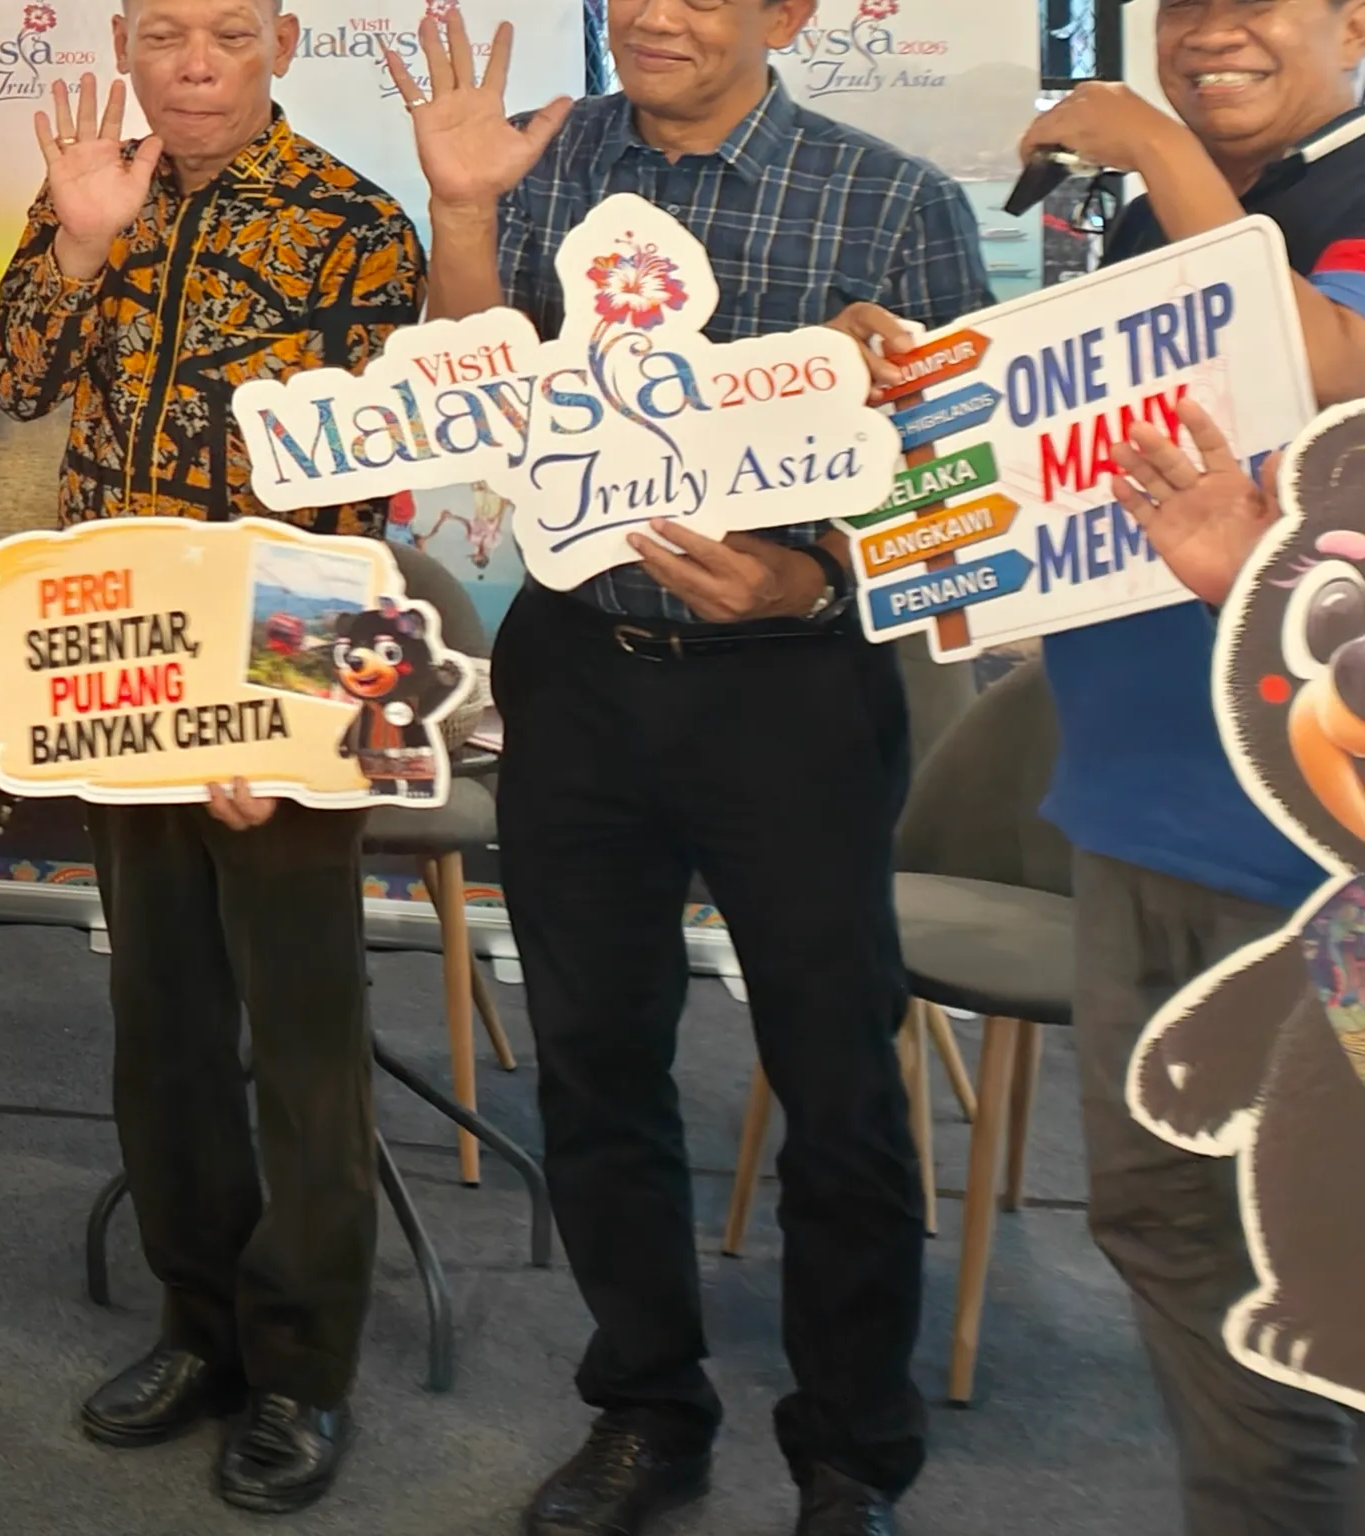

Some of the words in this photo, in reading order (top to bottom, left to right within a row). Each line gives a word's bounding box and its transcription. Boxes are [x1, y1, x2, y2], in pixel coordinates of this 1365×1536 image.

[55, 51, 95, 64] 2026
[890, 69, 946, 87] Asia
[413, 340, 519, 389] Visit
[1006, 326, 1108, 428] ONE
[1116, 282, 1234, 387] TRIP
[256, 328, 712, 485] Malaysia
[711, 356, 837, 409] 2026
[530, 450, 708, 554] Truly
[725, 435, 862, 496] Asia
[869, 507, 994, 565] LANGKAWI
[39, 569, 132, 619] PERGI
[889, 566, 998, 616] PENANG
[26, 611, 201, 672] SEBENTAR,
[50, 662, 184, 716] PULANG
[30, 711, 164, 765] BANYAK
[174, 697, 290, 749] CERITA
